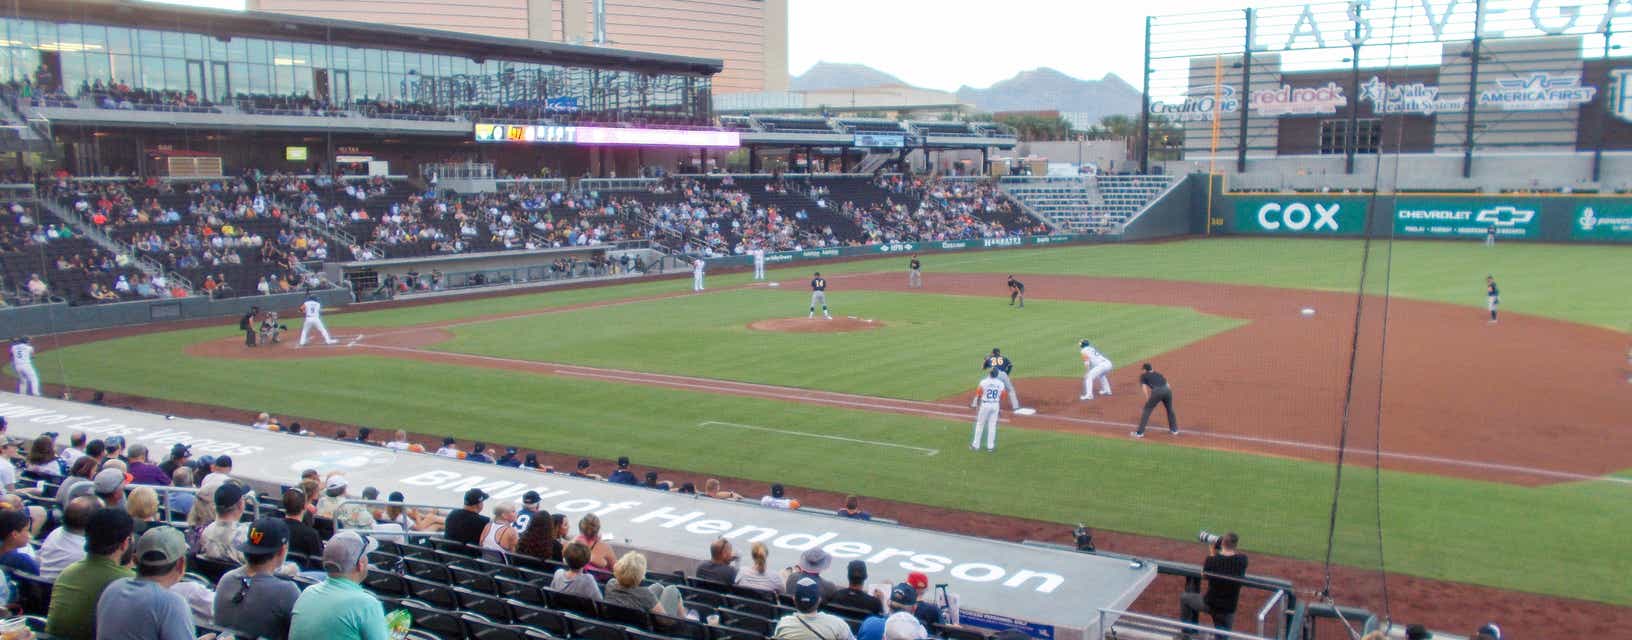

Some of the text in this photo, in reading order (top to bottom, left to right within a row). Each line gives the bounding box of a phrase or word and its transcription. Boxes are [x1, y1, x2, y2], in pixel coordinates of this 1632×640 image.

[1250, 0, 1372, 51] LAS
[1254, 82, 1341, 104] red rock
[1397, 84, 1440, 101] Valley
[1480, 88, 1594, 102] AMERICA FIRST
[1376, 98, 1465, 114] Health System
[1258, 203, 1340, 230] COX
[1398, 210, 1472, 220] CHEVROLET
[399, 470, 1065, 593] BMW of Henderson
